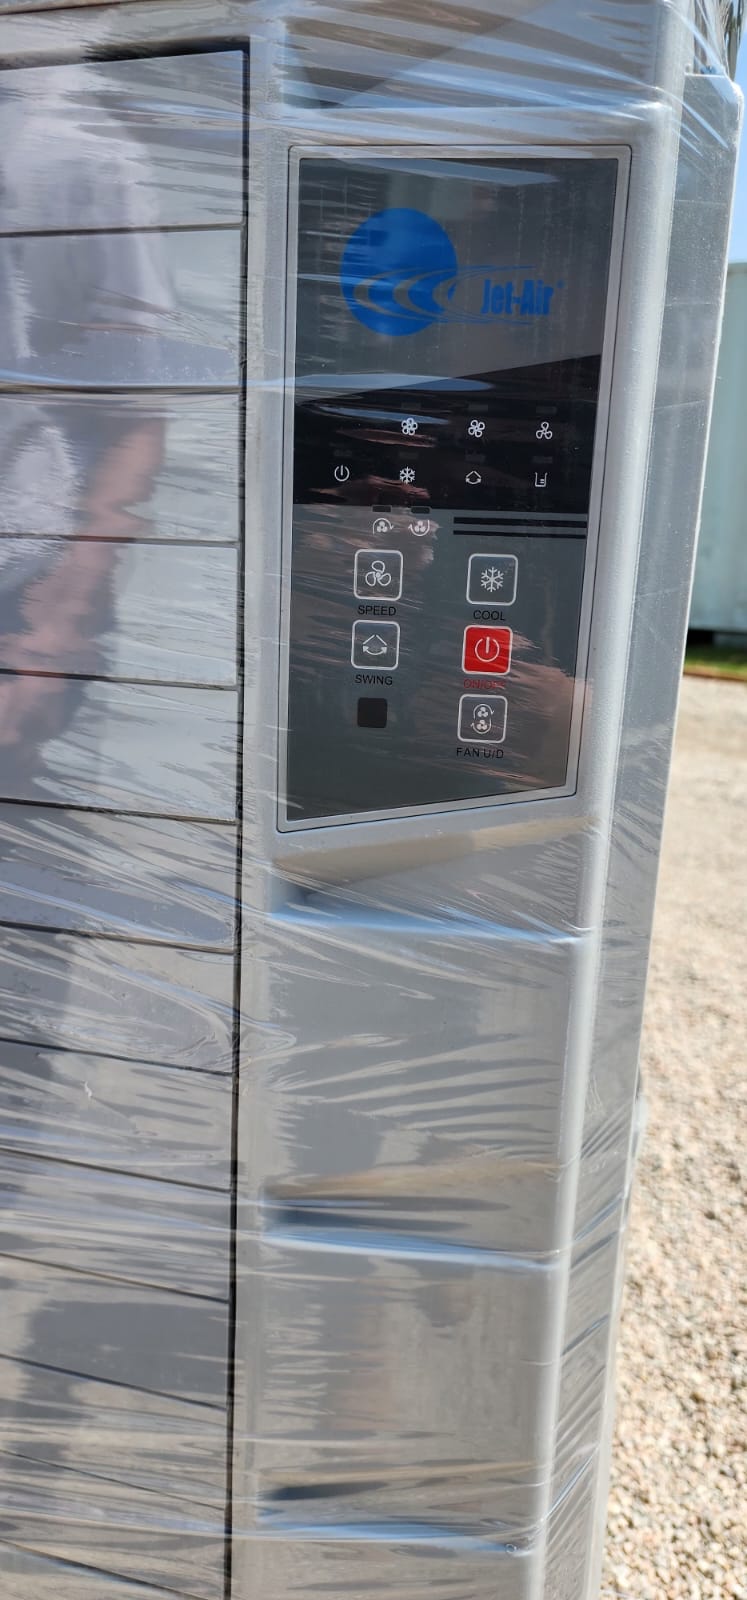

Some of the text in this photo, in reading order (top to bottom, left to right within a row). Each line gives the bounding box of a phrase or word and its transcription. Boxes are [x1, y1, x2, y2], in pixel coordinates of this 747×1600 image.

[481, 279, 554, 316] Jet-Air
[357, 605, 397, 616] SPEED
[473, 610, 506, 621] COOL
[355, 674, 393, 686] SWING
[456, 747, 504, 759] FAN U/D
